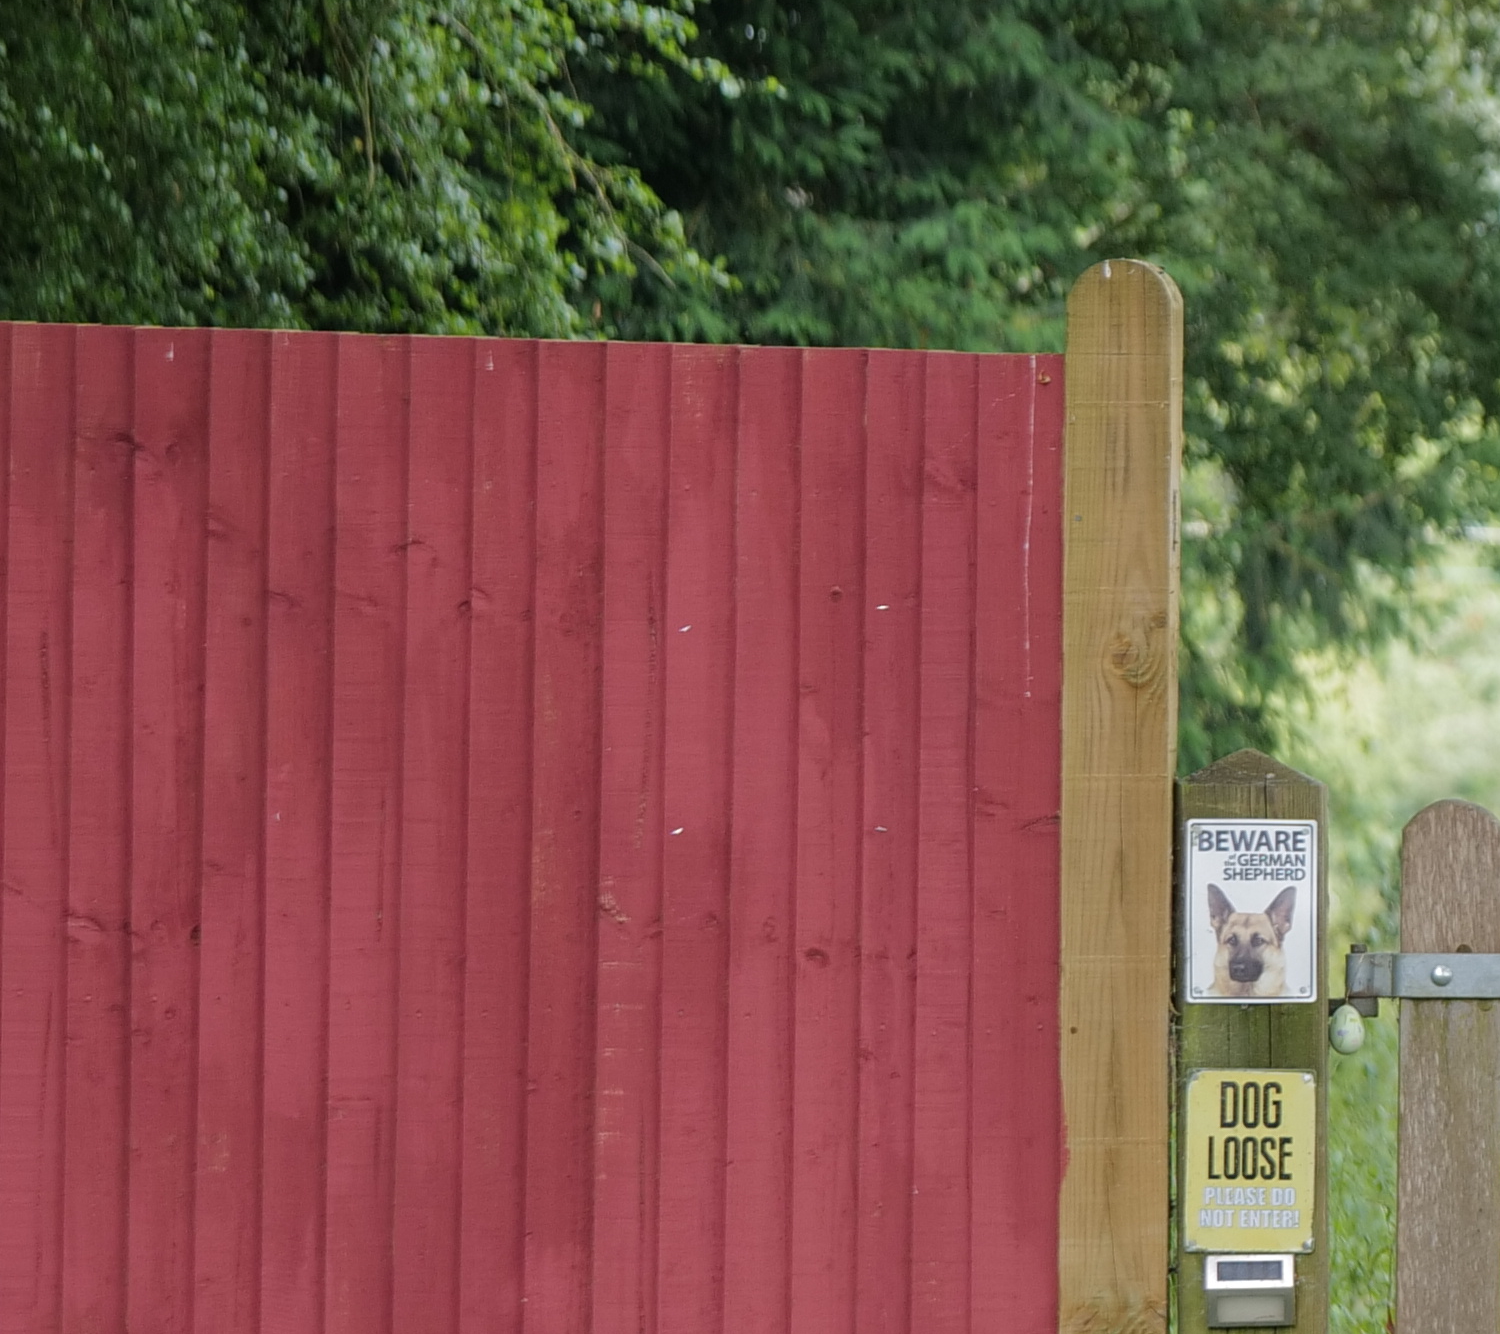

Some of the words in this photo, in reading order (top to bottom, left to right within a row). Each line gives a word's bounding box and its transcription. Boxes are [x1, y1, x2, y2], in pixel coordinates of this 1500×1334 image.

[1198, 830, 1307, 852] BEWARE
[1237, 853, 1306, 867] GERMAN
[1223, 867, 1306, 881] SHEPHERD
[1220, 1081, 1283, 1129] DOG
[1208, 1135, 1294, 1180] LOOSE
[1203, 1185, 1267, 1206] PLEASE
[1271, 1186, 1296, 1206] DO
[1199, 1209, 1235, 1228] NOT
[1239, 1209, 1301, 1229] ENTER!
